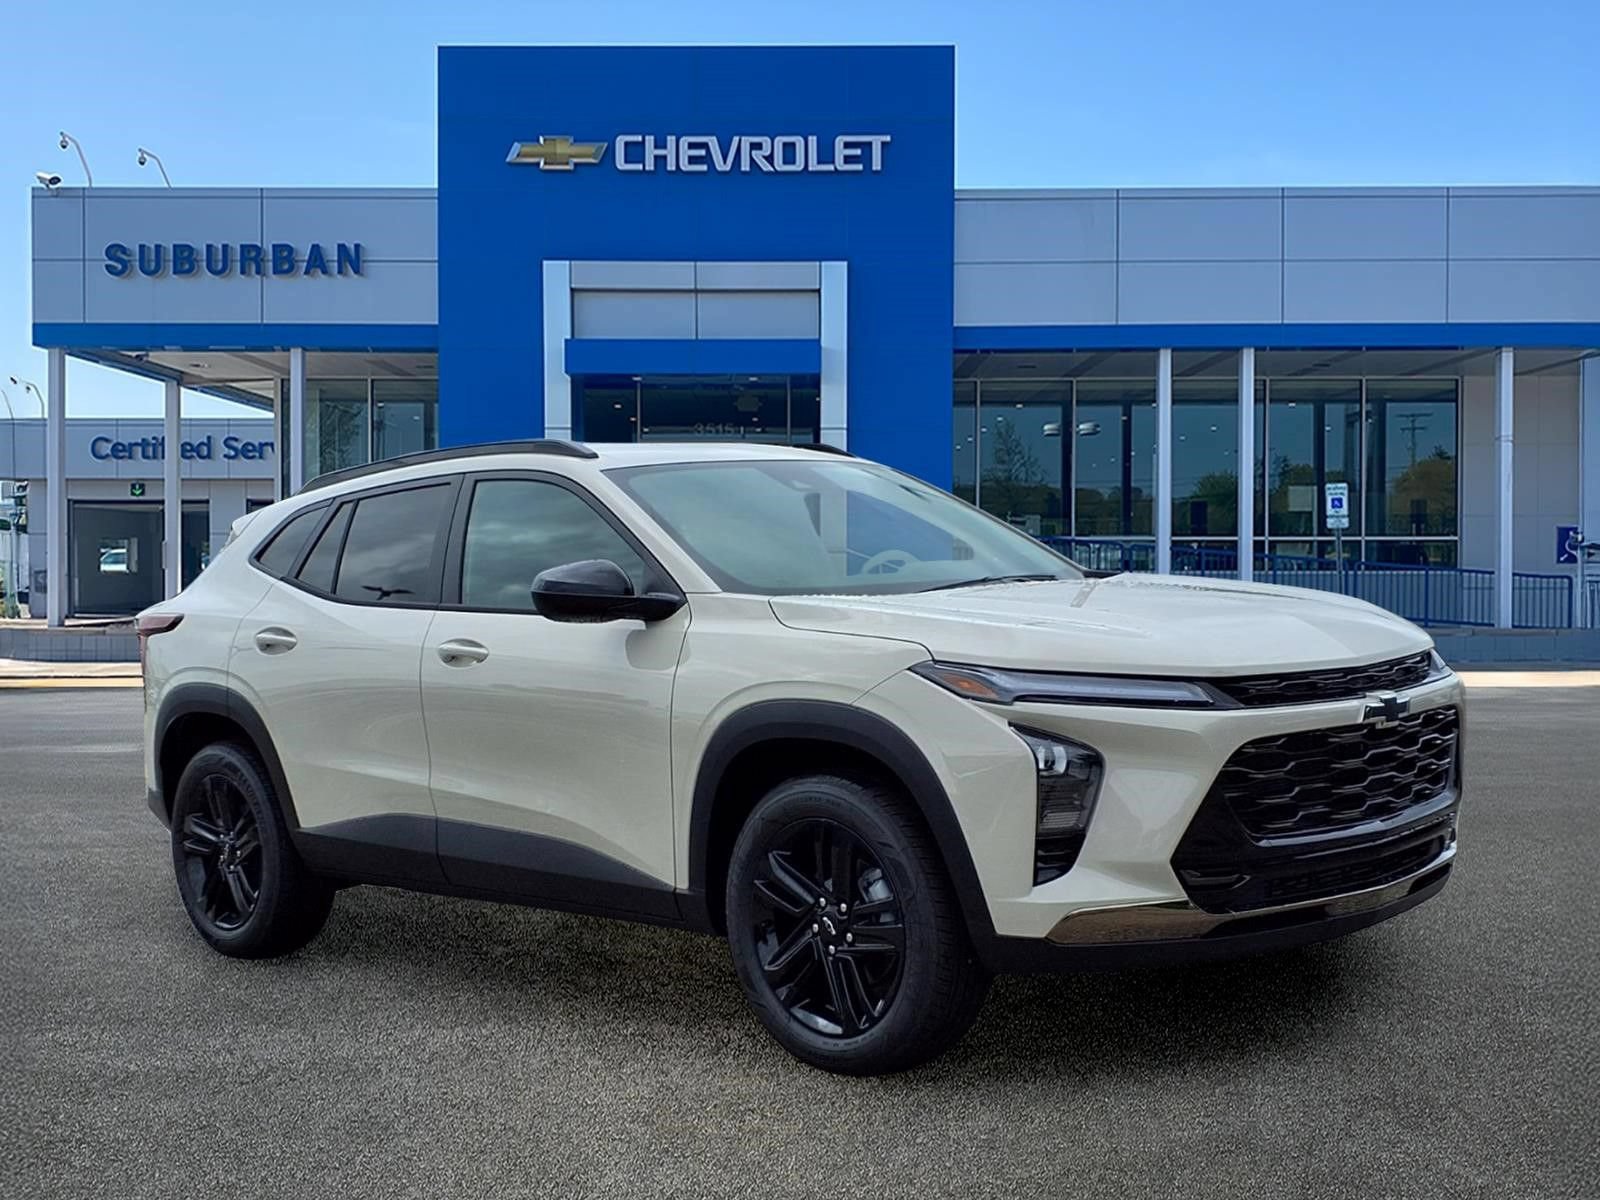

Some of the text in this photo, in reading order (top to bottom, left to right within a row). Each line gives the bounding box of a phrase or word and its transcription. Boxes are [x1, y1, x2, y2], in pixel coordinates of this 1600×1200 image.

[614, 134, 891, 172] CHEVROLET
[104, 242, 363, 277] SUBURBAN
[91, 436, 211, 460] Certifed
